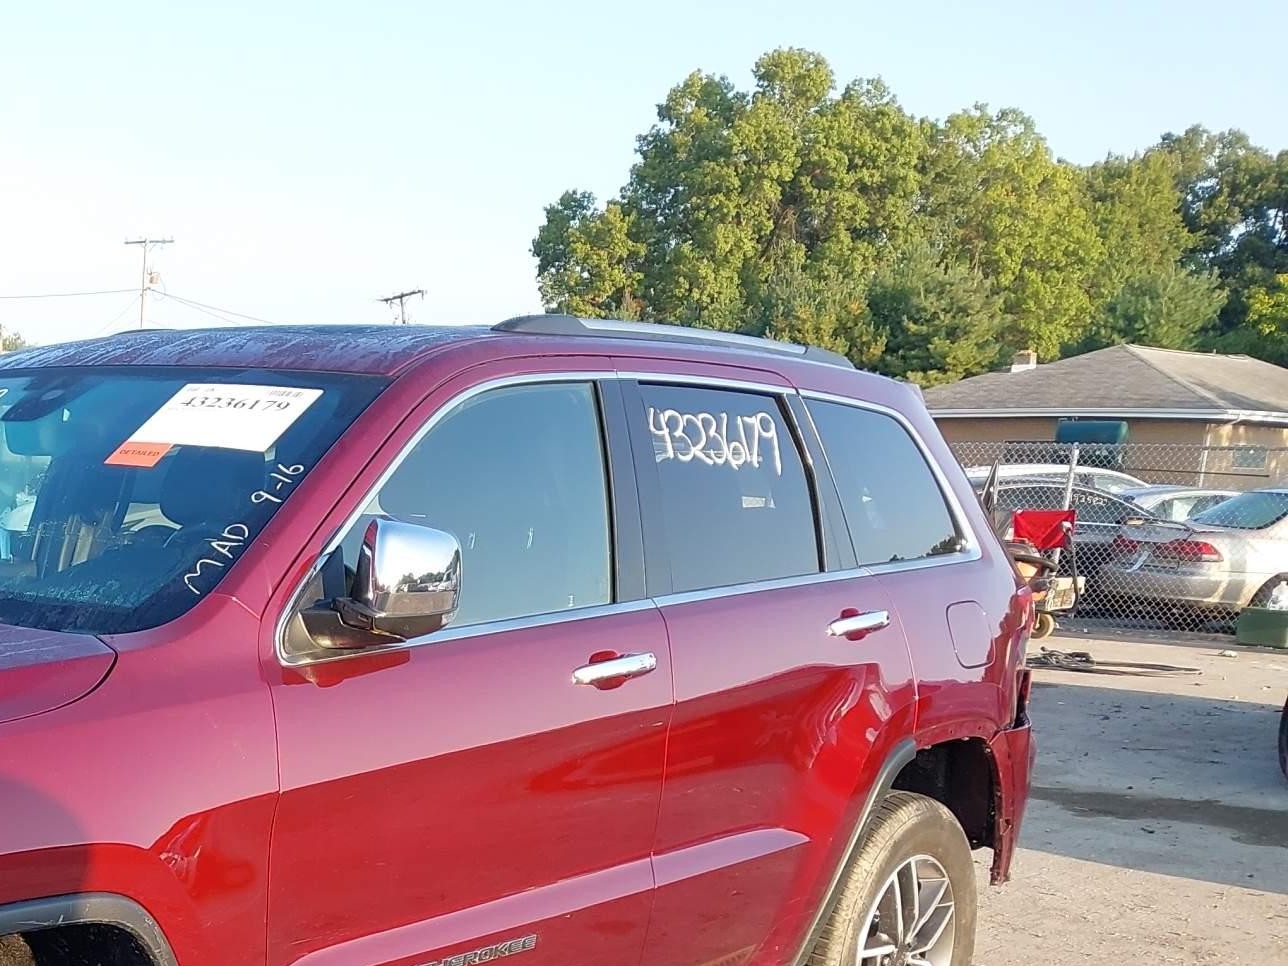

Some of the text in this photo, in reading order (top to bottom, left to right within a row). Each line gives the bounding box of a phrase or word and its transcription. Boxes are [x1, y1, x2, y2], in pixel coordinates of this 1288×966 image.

[180, 396, 291, 412] 43236179
[119, 448, 160, 458] DETAILED
[649, 407, 782, 476] 43236179
[184, 464, 305, 595] MAD 9-16
